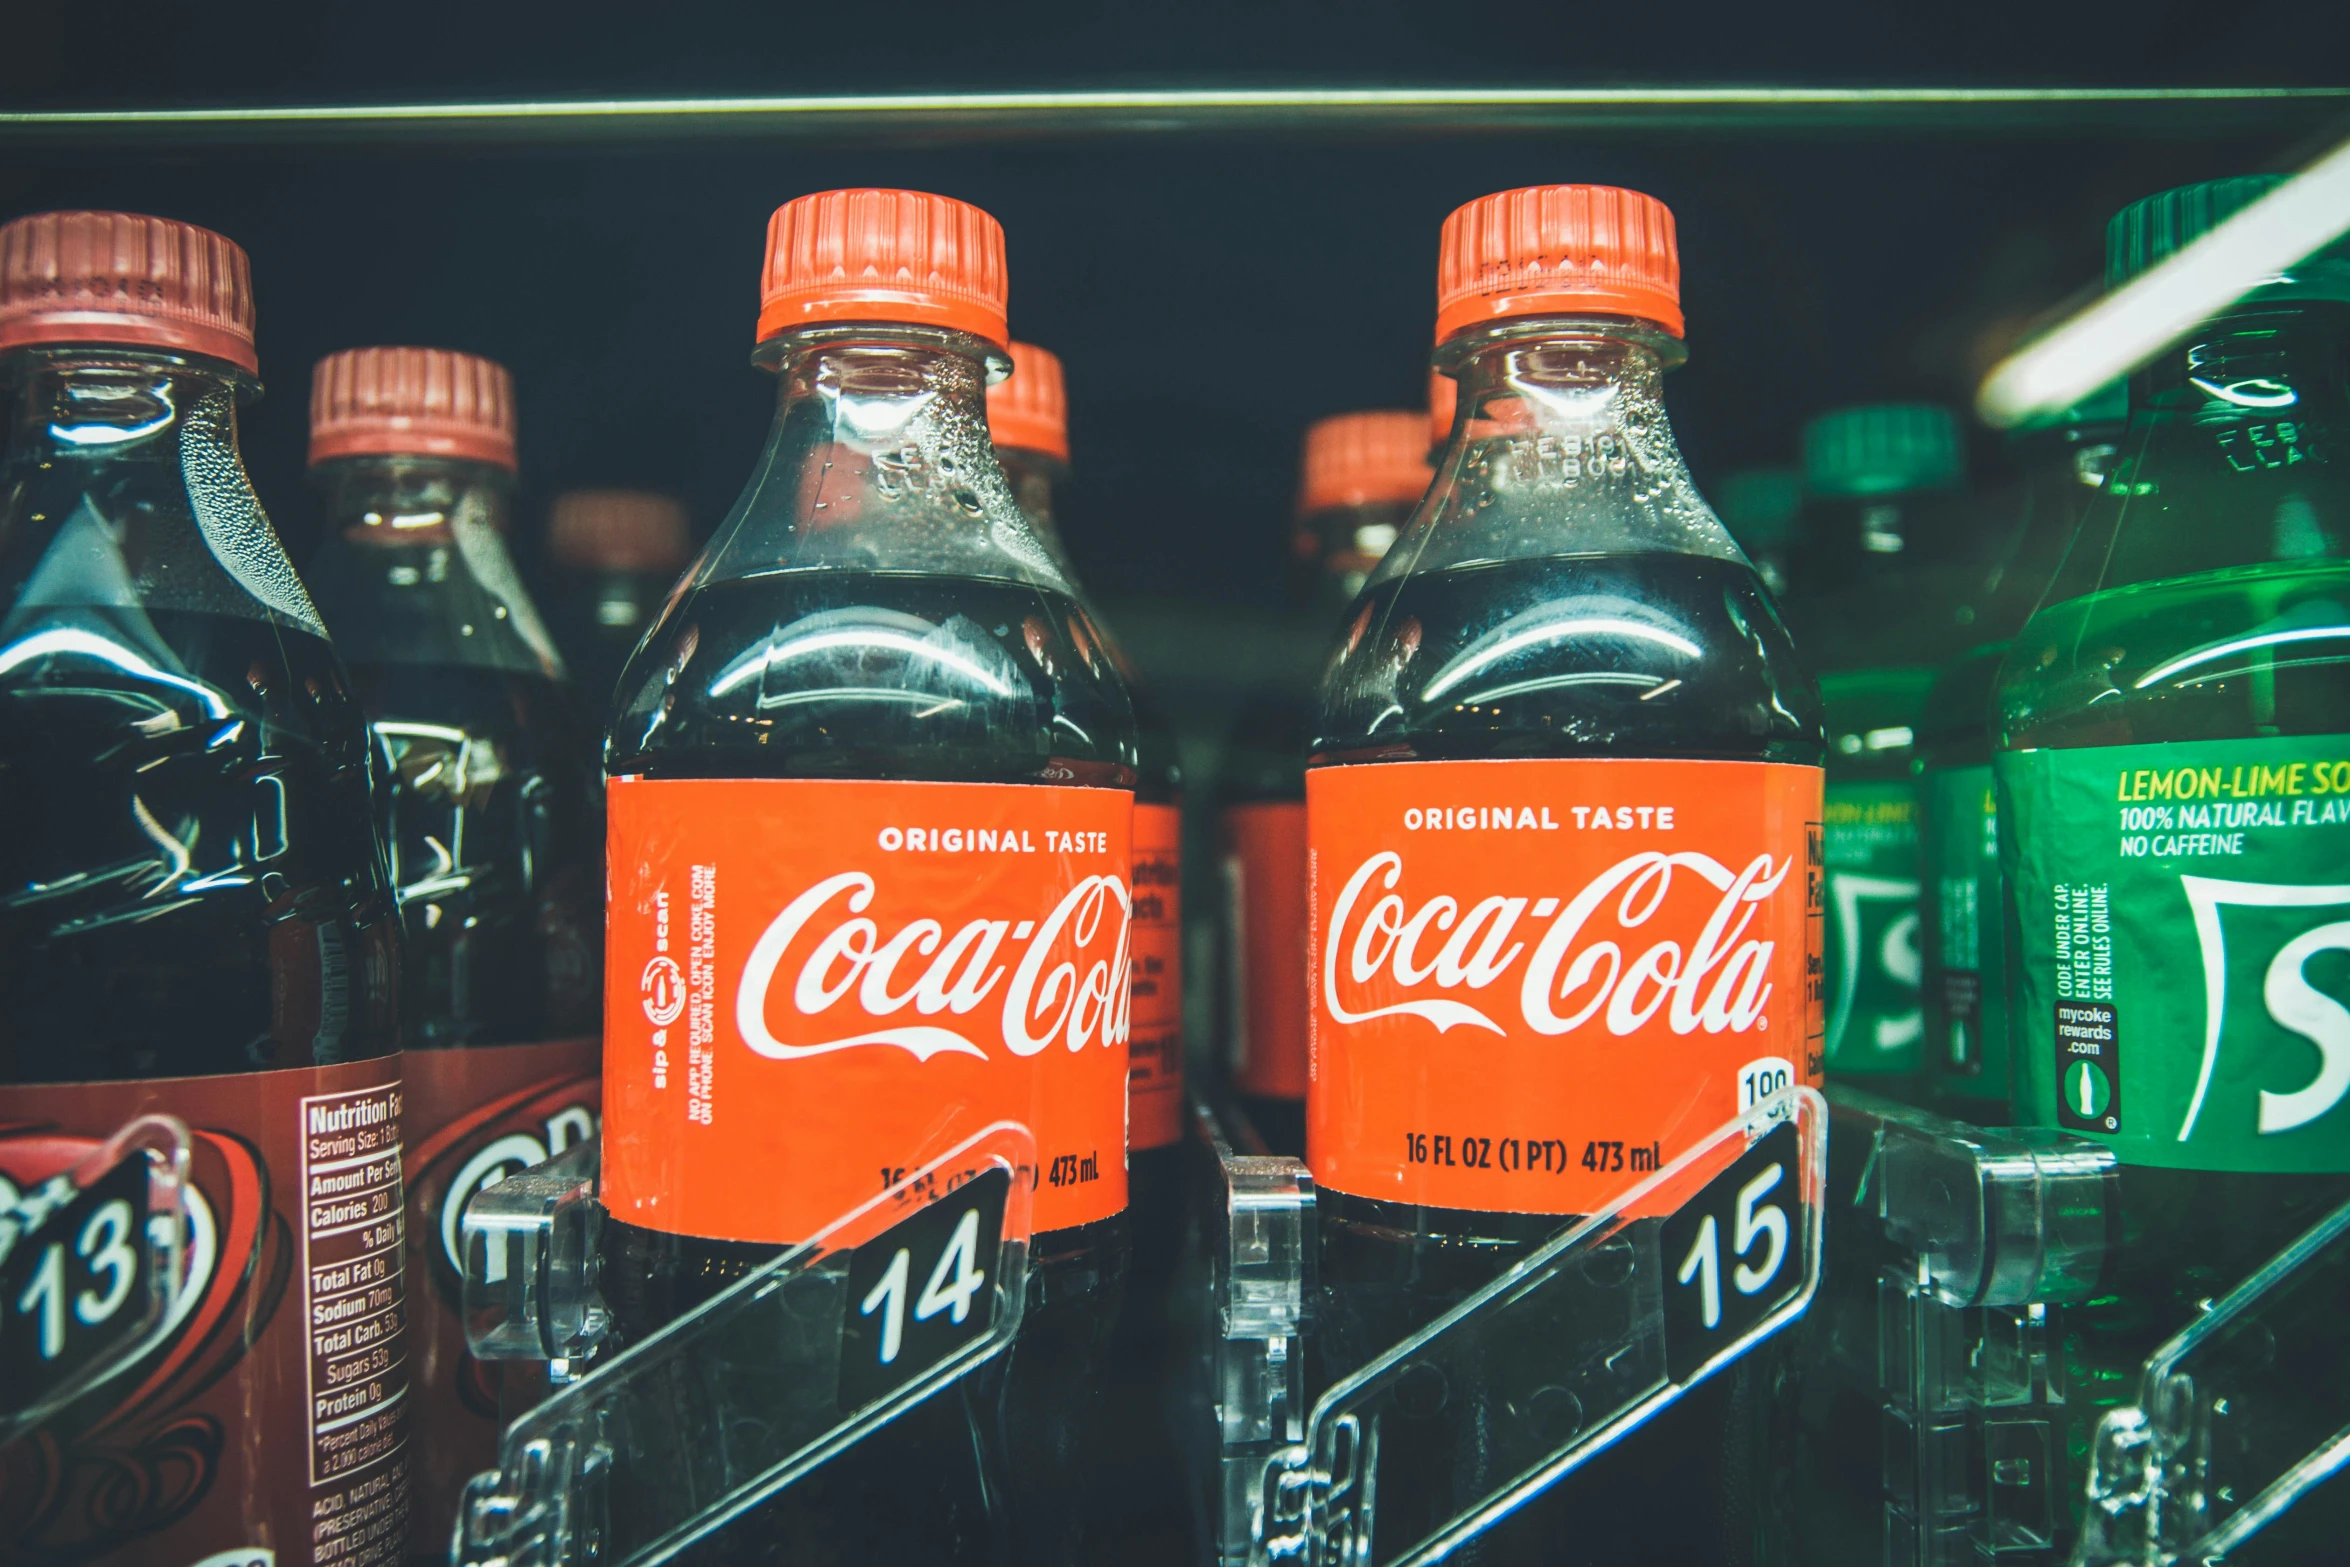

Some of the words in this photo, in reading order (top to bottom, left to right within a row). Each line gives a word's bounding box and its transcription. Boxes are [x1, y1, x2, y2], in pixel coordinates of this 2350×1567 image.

[2117, 762, 2304, 803] LEMON-LIME
[1404, 807, 1560, 831] ORIGINAL
[1571, 806, 1675, 830] TASTE
[2119, 804, 2173, 831] 100%
[2177, 800, 2286, 829] NATURAL
[877, 826, 1036, 854] ORIGINAL
[1045, 830, 1108, 854] TASTE
[2119, 836, 2148, 857] NO
[2151, 833, 2245, 857] CAFFEINE
[2054, 882, 2070, 910] CAP.
[2071, 883, 2090, 945] ONLINE.
[2091, 882, 2110, 933] ONLINE.
[656, 892, 669, 952] scan
[703, 911, 716, 958] ENJOY
[2055, 914, 2071, 959] UNDER
[1324, 850, 1794, 1038] Coca-Cola
[2092, 935, 2111, 975] RULES
[690, 946, 703, 986] OPEN
[2057, 963, 2072, 997] CODE
[2073, 950, 2091, 998] ENTER
[2093, 977, 2112, 1000] SEE
[702, 1003, 714, 1043] SCAN
[2058, 1007, 2112, 1024] mycoke
[2059, 1023, 2112, 1040] rewards
[652, 1028, 668, 1048] &
[2067, 1040, 2100, 1056] .com
[653, 1050, 669, 1089] sip
[688, 1067, 701, 1095] APP
[309, 1098, 387, 1134] Nutrition
[688, 1099, 700, 1121] NO
[700, 1104, 712, 1126] ON
[310, 1135, 356, 1159] Serving
[358, 1130, 379, 1151] Size:
[1406, 1133, 1427, 1163] 16
[1433, 1136, 1456, 1167] FL
[1462, 1137, 1491, 1169] OZ
[1499, 1138, 1519, 1173] (1
[1526, 1138, 1567, 1175] PT)
[1581, 1140, 1624, 1172] 473
[311, 1168, 364, 1196] Amount
[367, 1165, 384, 1184] Per
[1048, 1154, 1077, 1187] 473
[1080, 1150, 1099, 1183] mL
[311, 1200, 367, 1228] Calories
[372, 1192, 388, 1214] 200
[363, 1230, 374, 1249] %
[376, 1222, 396, 1246] Daily
[1677, 1161, 1789, 1329] 15
[17, 1198, 138, 1360] 13
[312, 1267, 350, 1293] Total
[353, 1261, 372, 1284] Fat
[373, 1258, 386, 1278] 0g
[859, 1208, 985, 1365] 14
[313, 1297, 366, 1325] Sodium
[368, 1287, 393, 1310] 70mg
[314, 1328, 352, 1356] Total
[354, 1320, 383, 1345] Carb.
[385, 1312, 398, 1332] 53g
[327, 1356, 370, 1385] Sugars
[372, 1347, 389, 1369] 53g
[316, 1387, 367, 1419] Protein
[369, 1382, 382, 1402] 0g
[350, 1472, 390, 1505] NATURAL
[314, 1528, 366, 1564] BOTTLED
